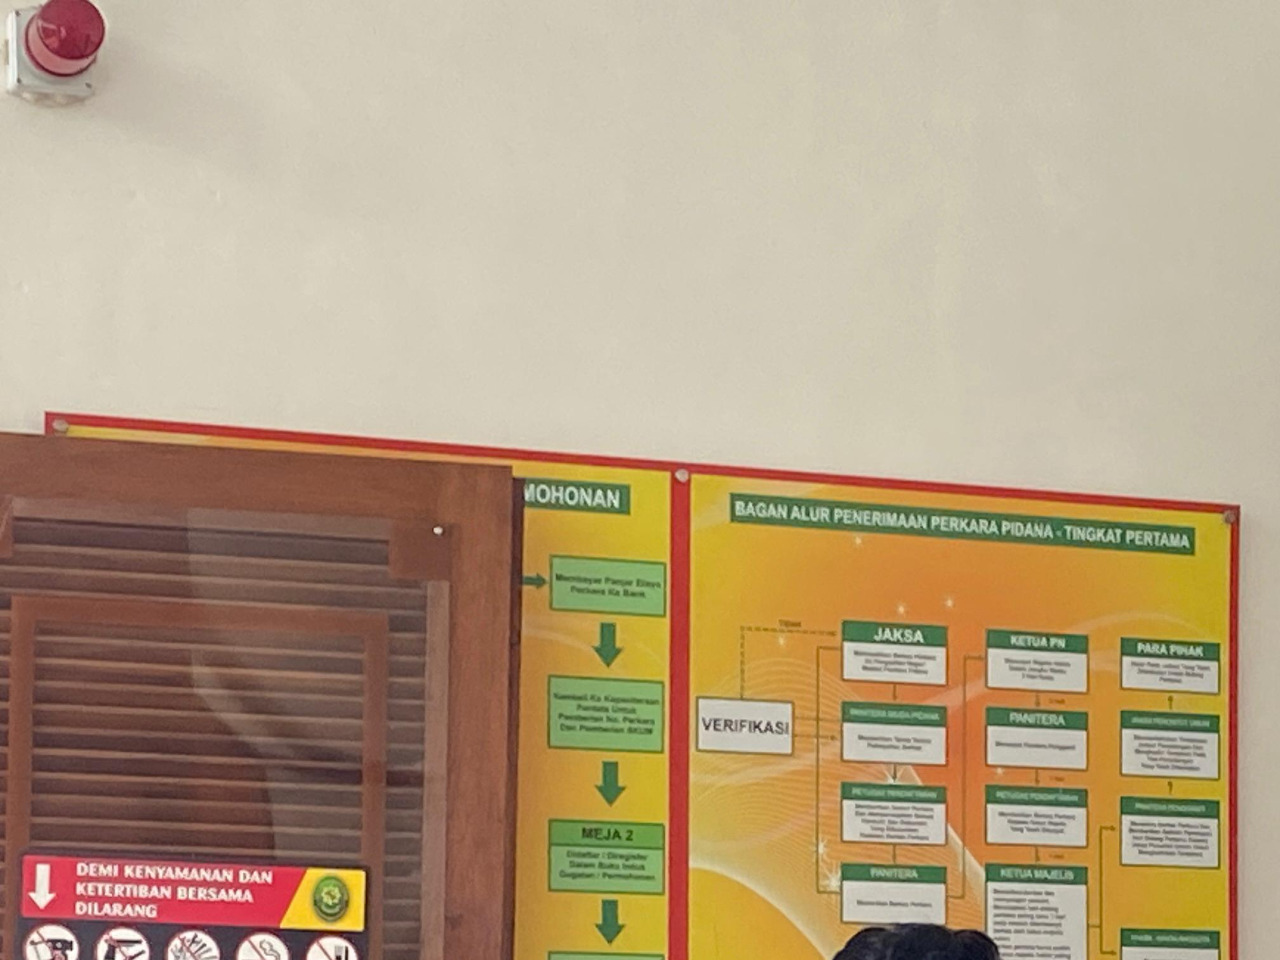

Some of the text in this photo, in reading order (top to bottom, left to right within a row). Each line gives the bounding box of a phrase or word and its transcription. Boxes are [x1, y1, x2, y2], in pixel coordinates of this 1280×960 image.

[734, 500, 787, 519] BAGAN
[790, 505, 831, 523] ALUR
[833, 508, 928, 530] PENERIMAAN
[931, 515, 999, 535] PERKARA
[1001, 520, 1053, 539] PIDANA
[1064, 525, 1122, 544] TINGKAT
[1126, 529, 1190, 549] PERTAMA
[873, 627, 924, 643] JAKSA
[1010, 634, 1066, 649] KETUA PN
[1137, 642, 1204, 657] PARA PIHAK
[701, 717, 789, 735] VERIFIKASI
[581, 827, 634, 842] MEJA 2
[76, 862, 274, 884] DEMI KENYAMANAN DAN
[76, 882, 253, 903] KETERTIBAN BERSAMA
[75, 902, 158, 918] DILARANG
